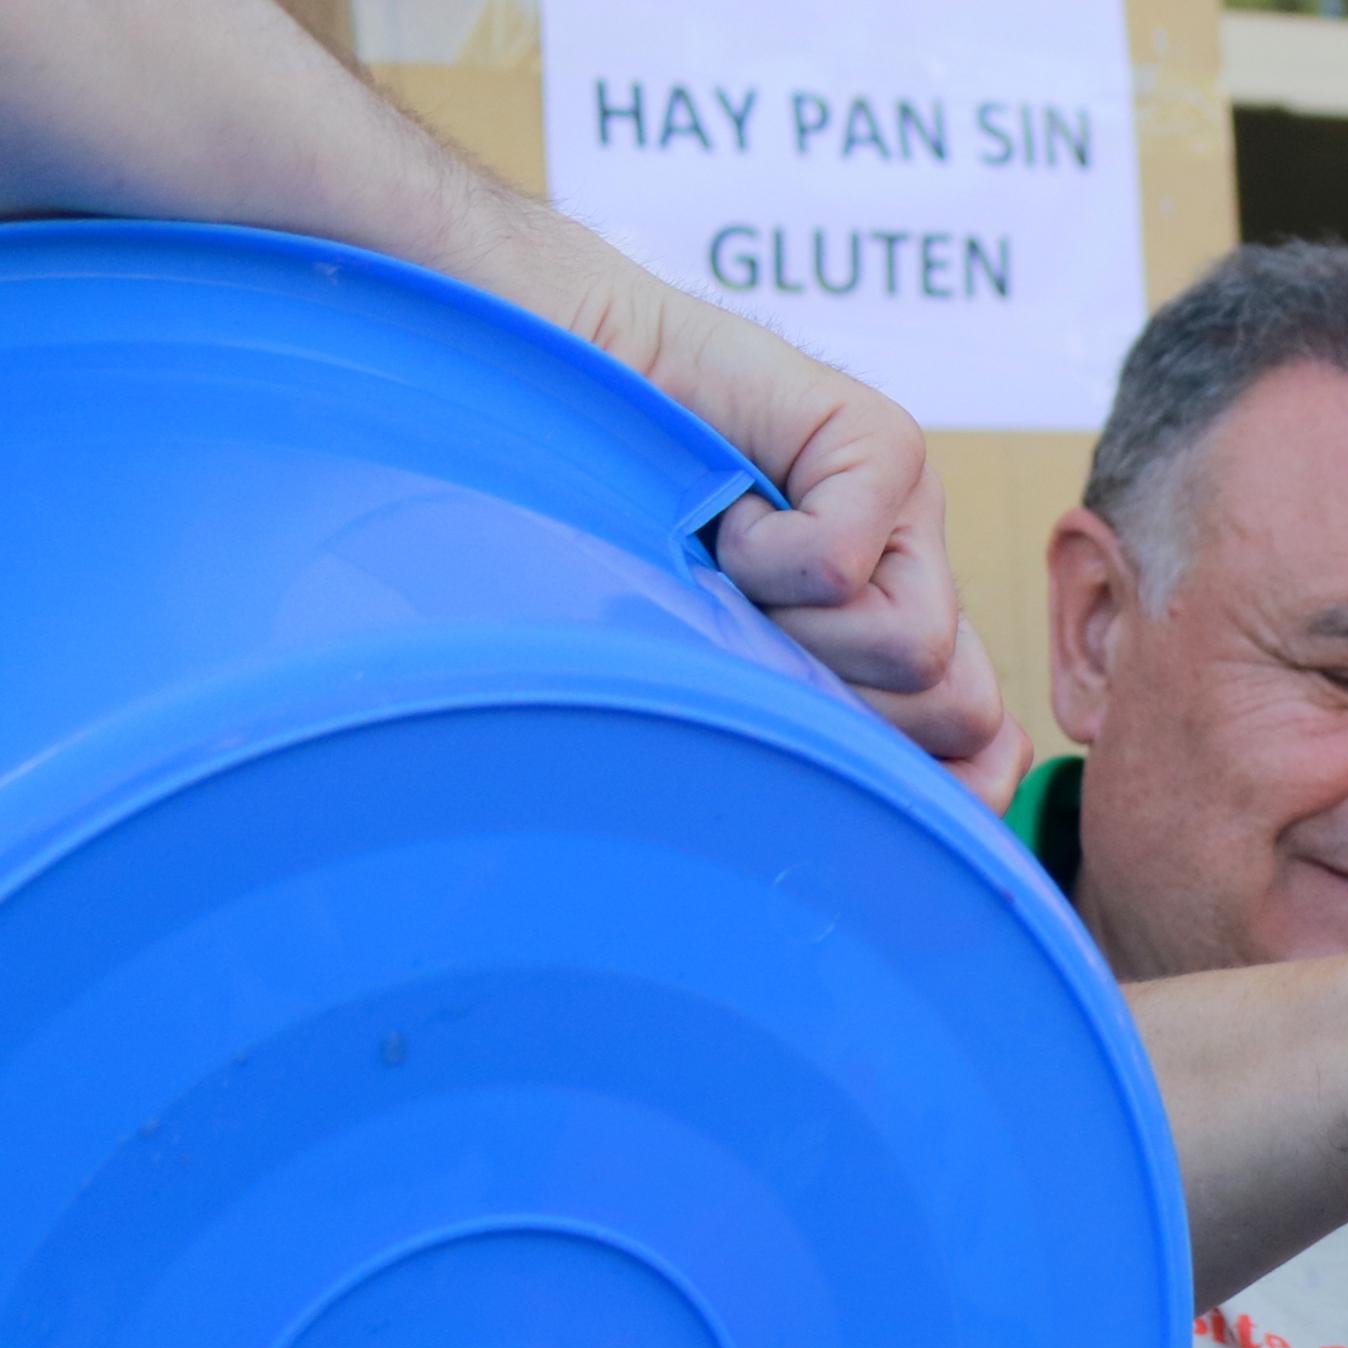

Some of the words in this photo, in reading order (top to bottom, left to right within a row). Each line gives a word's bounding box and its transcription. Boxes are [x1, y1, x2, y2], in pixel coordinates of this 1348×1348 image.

[595, 79, 758, 152] HAY
[791, 91, 949, 163] PAN
[975, 102, 1092, 169] SIN
[707, 224, 1011, 300] GLUTEN
